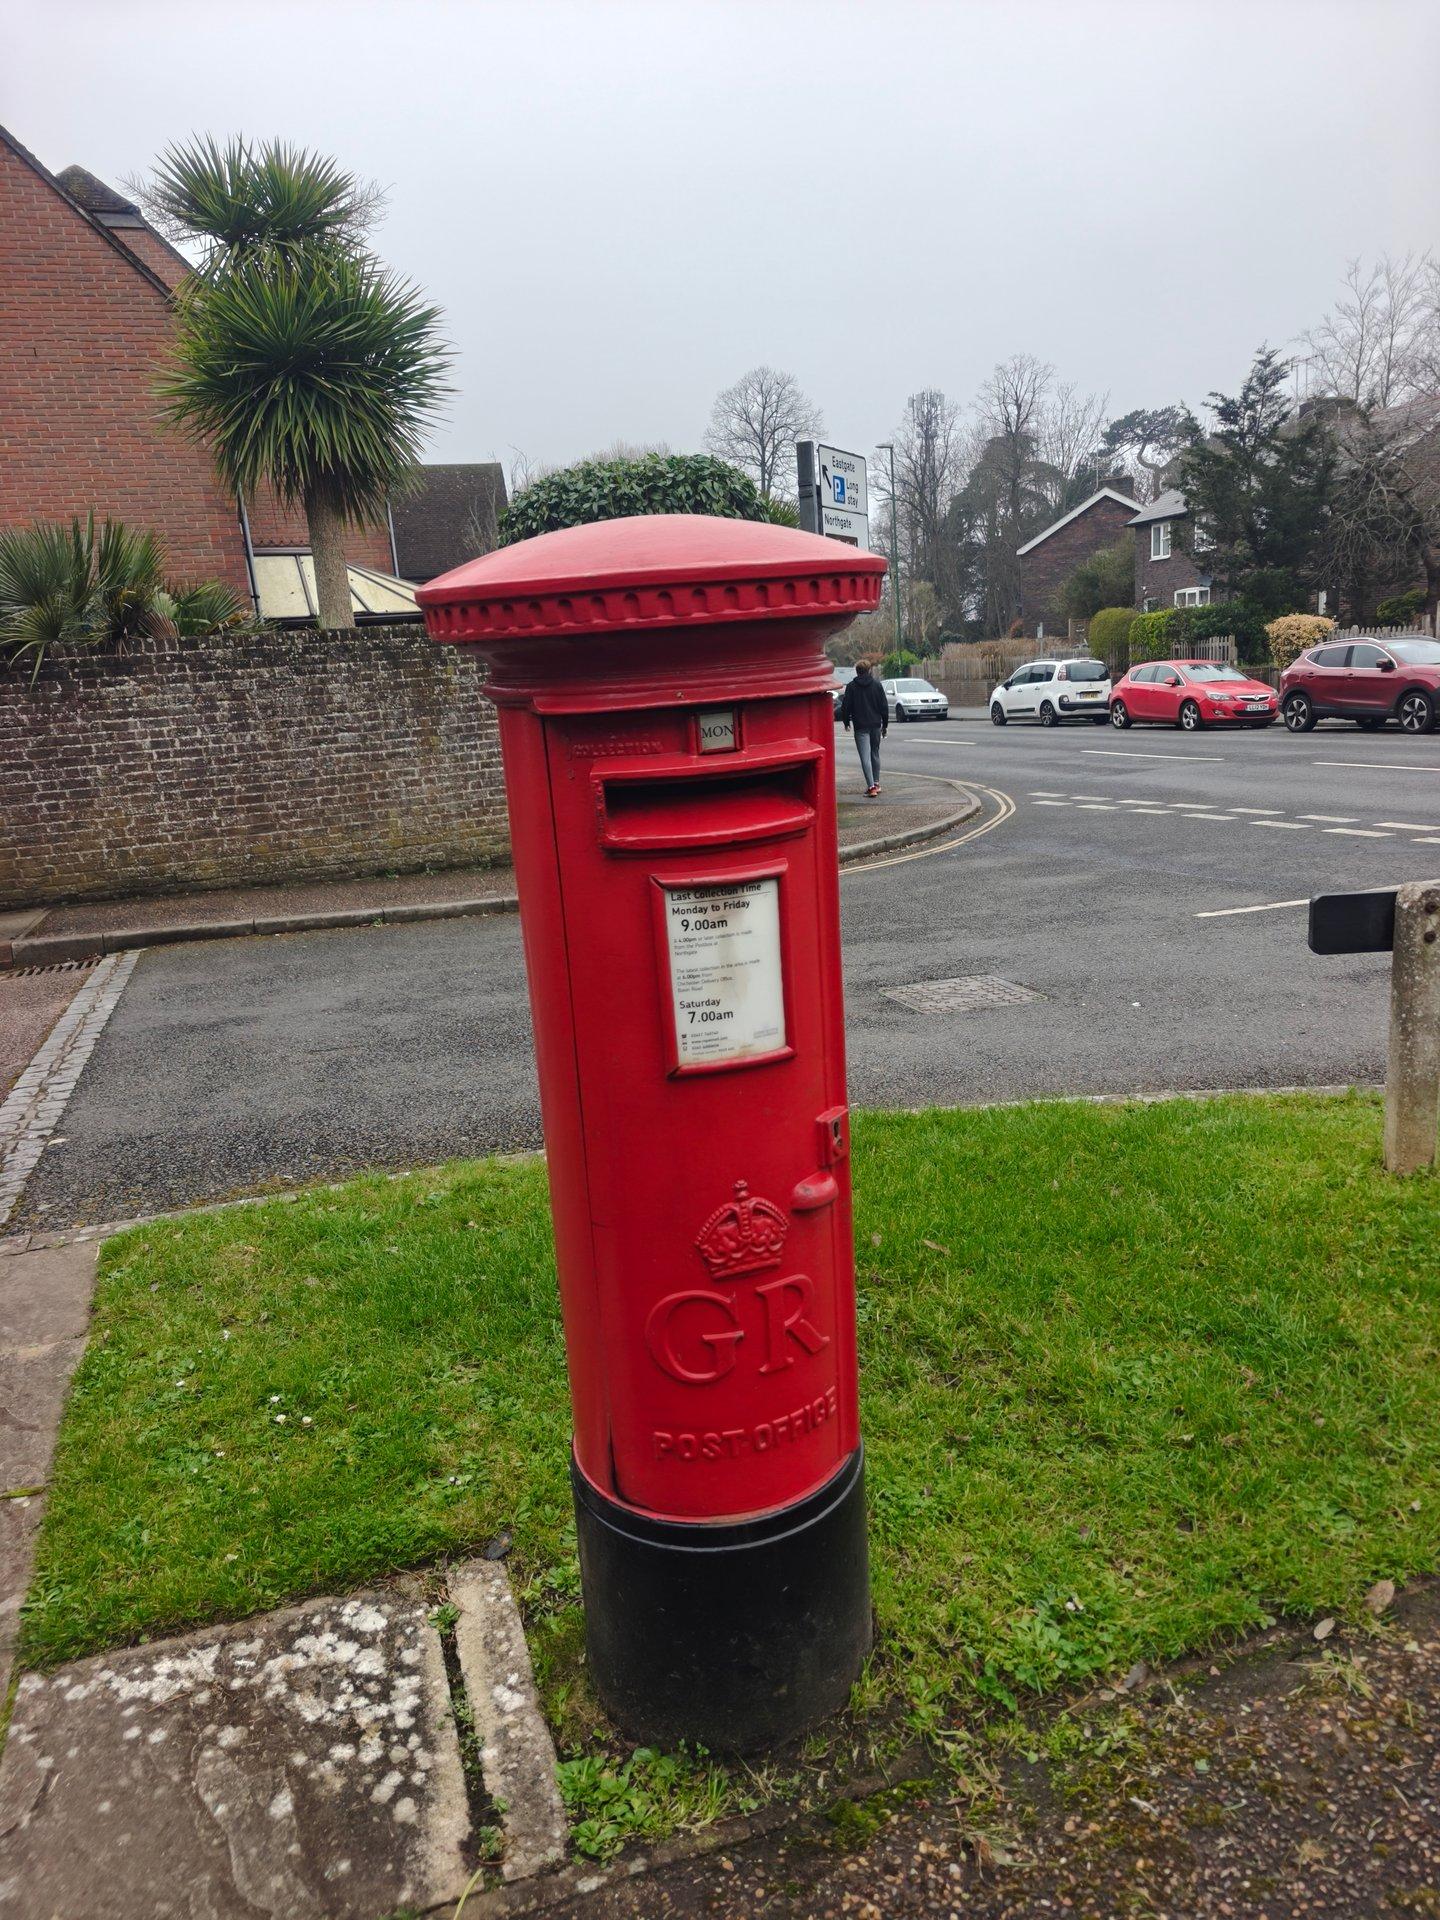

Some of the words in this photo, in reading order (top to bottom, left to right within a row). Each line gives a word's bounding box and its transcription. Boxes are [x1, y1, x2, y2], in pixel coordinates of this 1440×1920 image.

[832, 456, 855, 472] Eastgate
[846, 478, 859, 493] Long
[847, 495, 858, 508] stay
[825, 513, 852, 529] Northgate
[701, 723, 735, 739] MON
[671, 892, 691, 901] Last
[694, 888, 738, 899] Collection
[740, 883, 762, 892] Time
[672, 906, 708, 916] Monday
[711, 904, 721, 912] to
[723, 900, 750, 910] Friday
[681, 919, 728, 932] 9.00am
[679, 998, 721, 1009] Saturday
[688, 1010, 734, 1024] 7.00am
[645, 1274, 830, 1385] GR
[653, 1429, 745, 1460] POST
[754, 1385, 837, 1452] OFFICE
